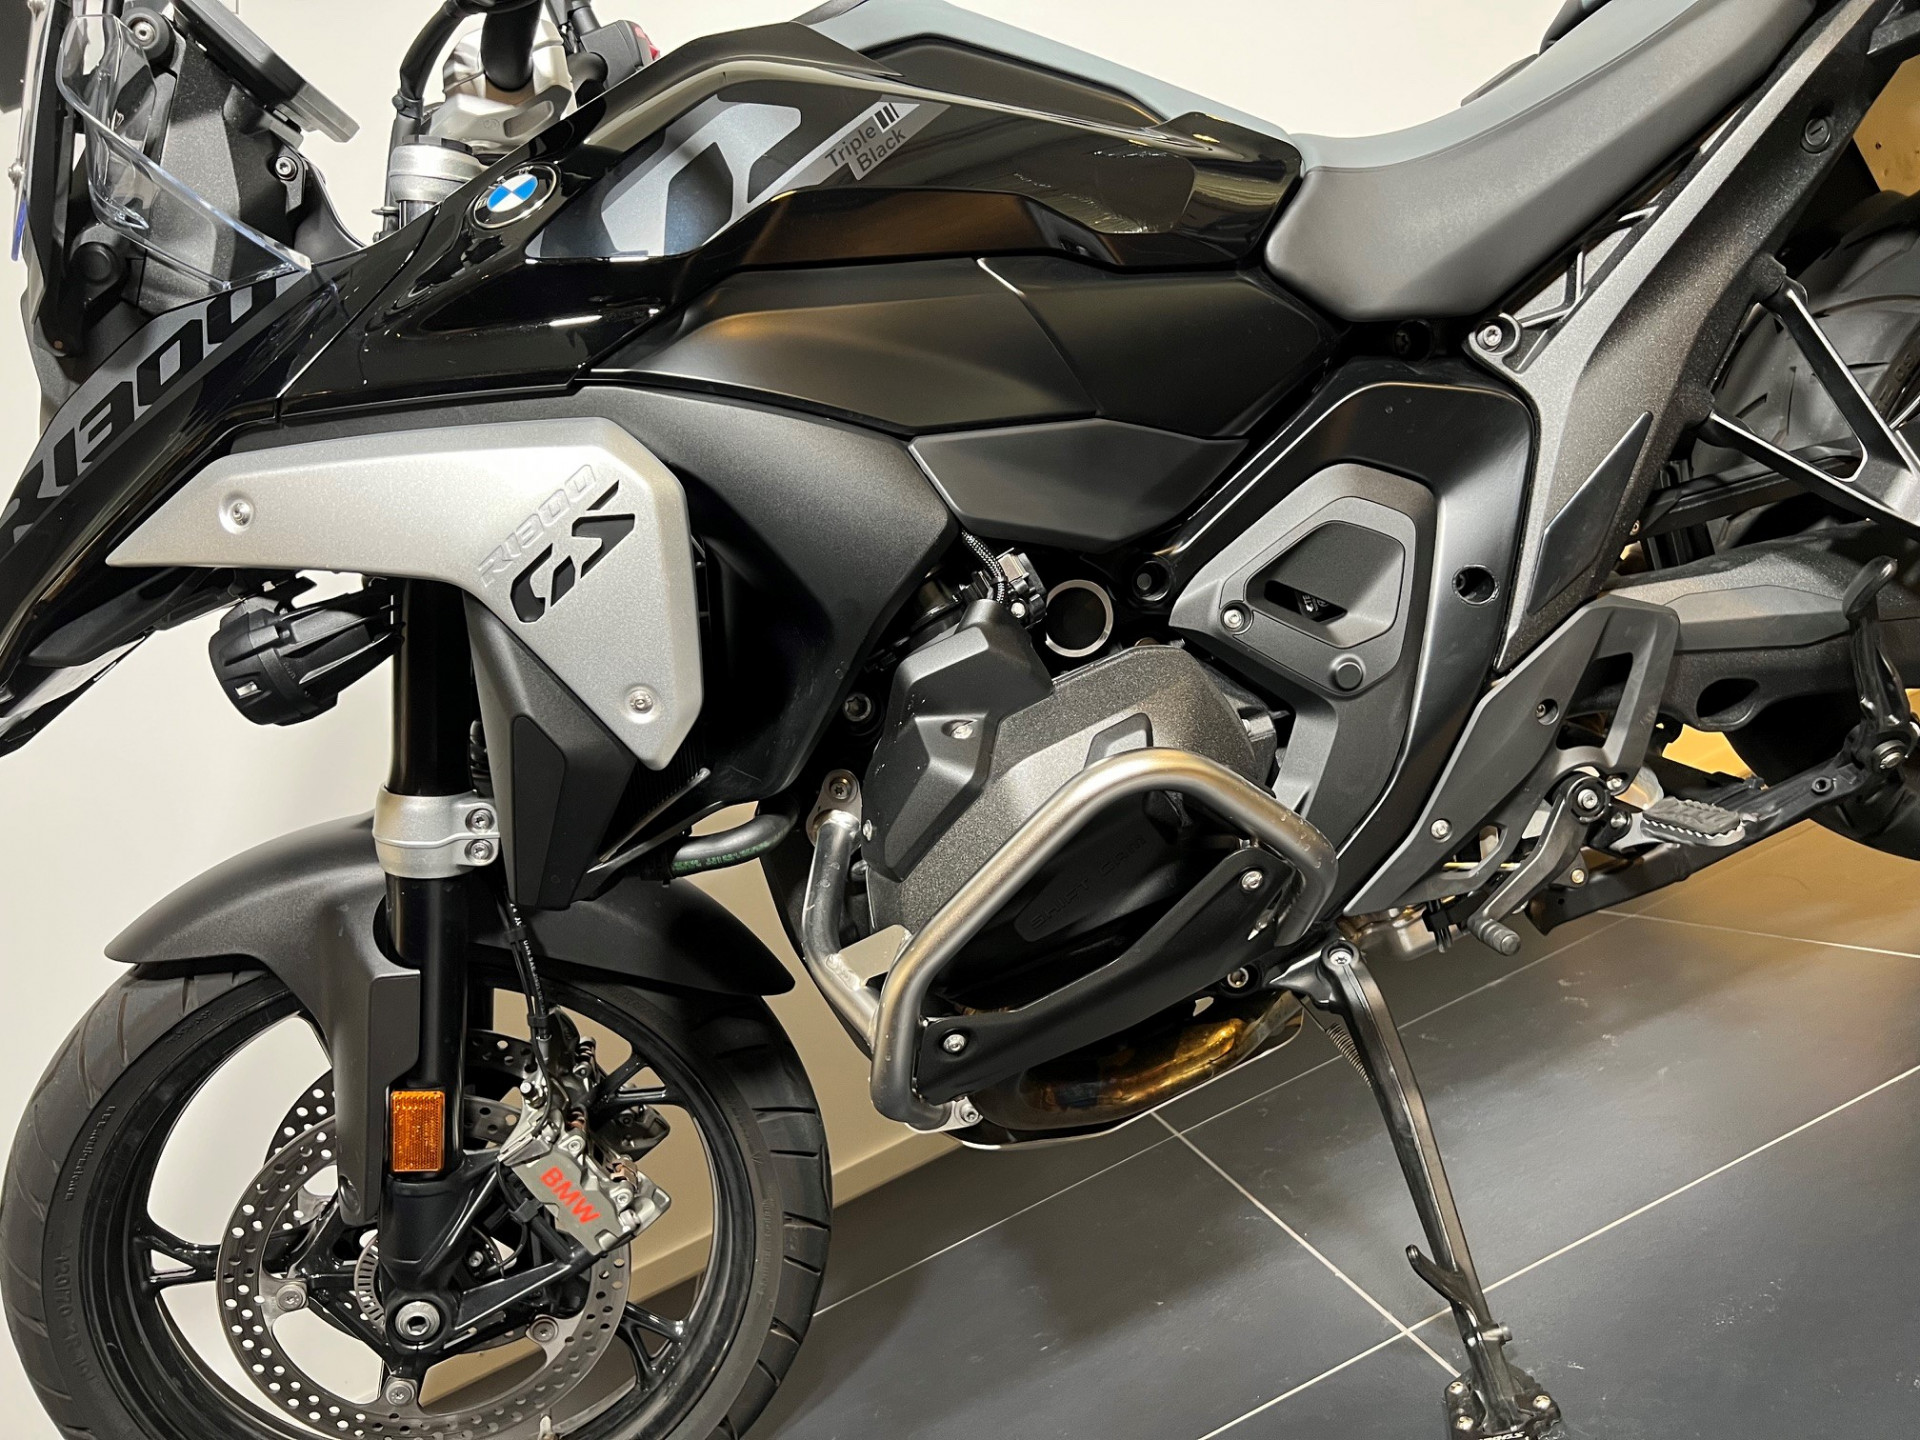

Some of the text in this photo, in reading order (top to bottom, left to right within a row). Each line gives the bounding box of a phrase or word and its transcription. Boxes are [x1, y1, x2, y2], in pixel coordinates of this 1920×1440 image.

[825, 126, 876, 167] Triple
[856, 129, 906, 172] Black
[477, 464, 597, 588] R1300
[510, 480, 635, 623] GS
[540, 1166, 600, 1224] BMW
